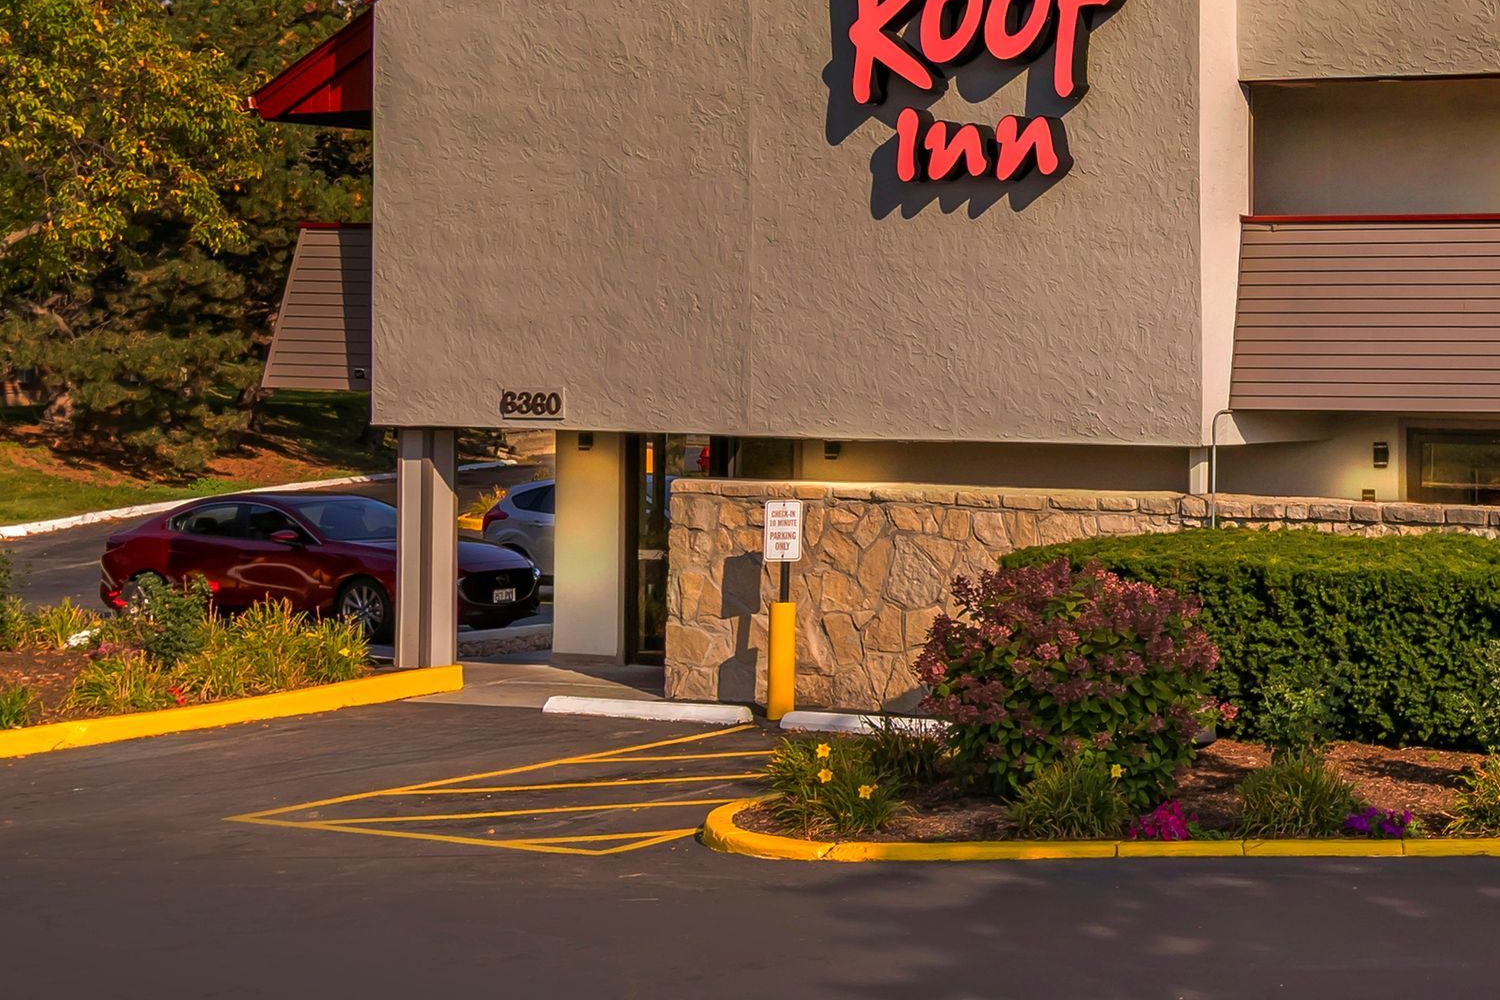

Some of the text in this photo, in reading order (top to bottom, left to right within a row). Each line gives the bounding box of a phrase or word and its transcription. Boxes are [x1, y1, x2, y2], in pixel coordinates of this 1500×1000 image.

[500, 391, 562, 415] 6360
[769, 531, 797, 540] PARKING
[775, 542, 790, 550] ONLY
